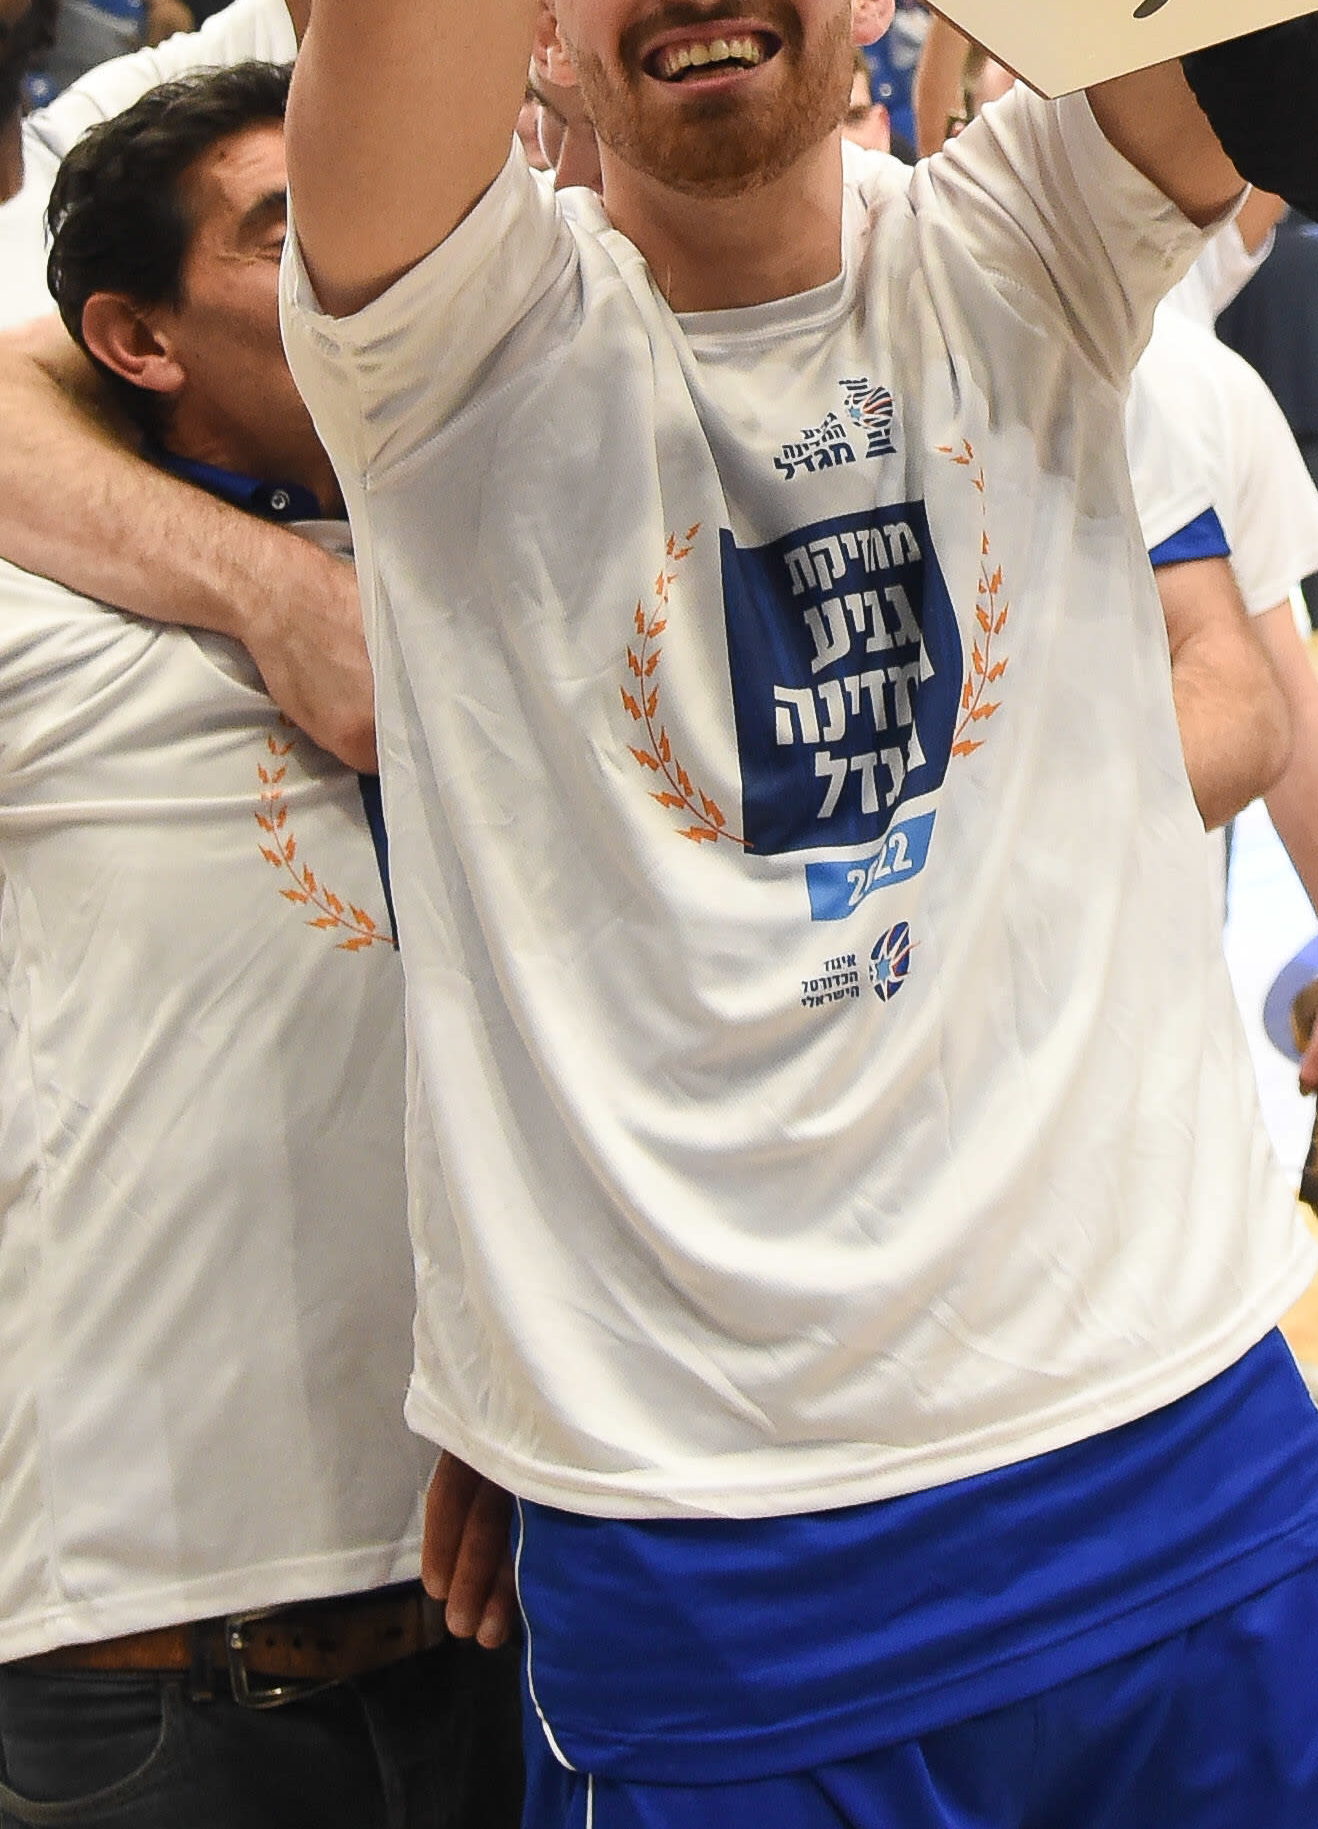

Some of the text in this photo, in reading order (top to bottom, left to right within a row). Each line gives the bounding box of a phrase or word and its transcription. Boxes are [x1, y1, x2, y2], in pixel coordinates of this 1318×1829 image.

[773, 442, 856, 481] מגדל
[783, 521, 922, 596] מחזיקת
[803, 584, 923, 675] גביע
[823, 953, 857, 972] איגוד
[801, 970, 859, 994] הכדורסל
[801, 985, 860, 1008] הישראלי
